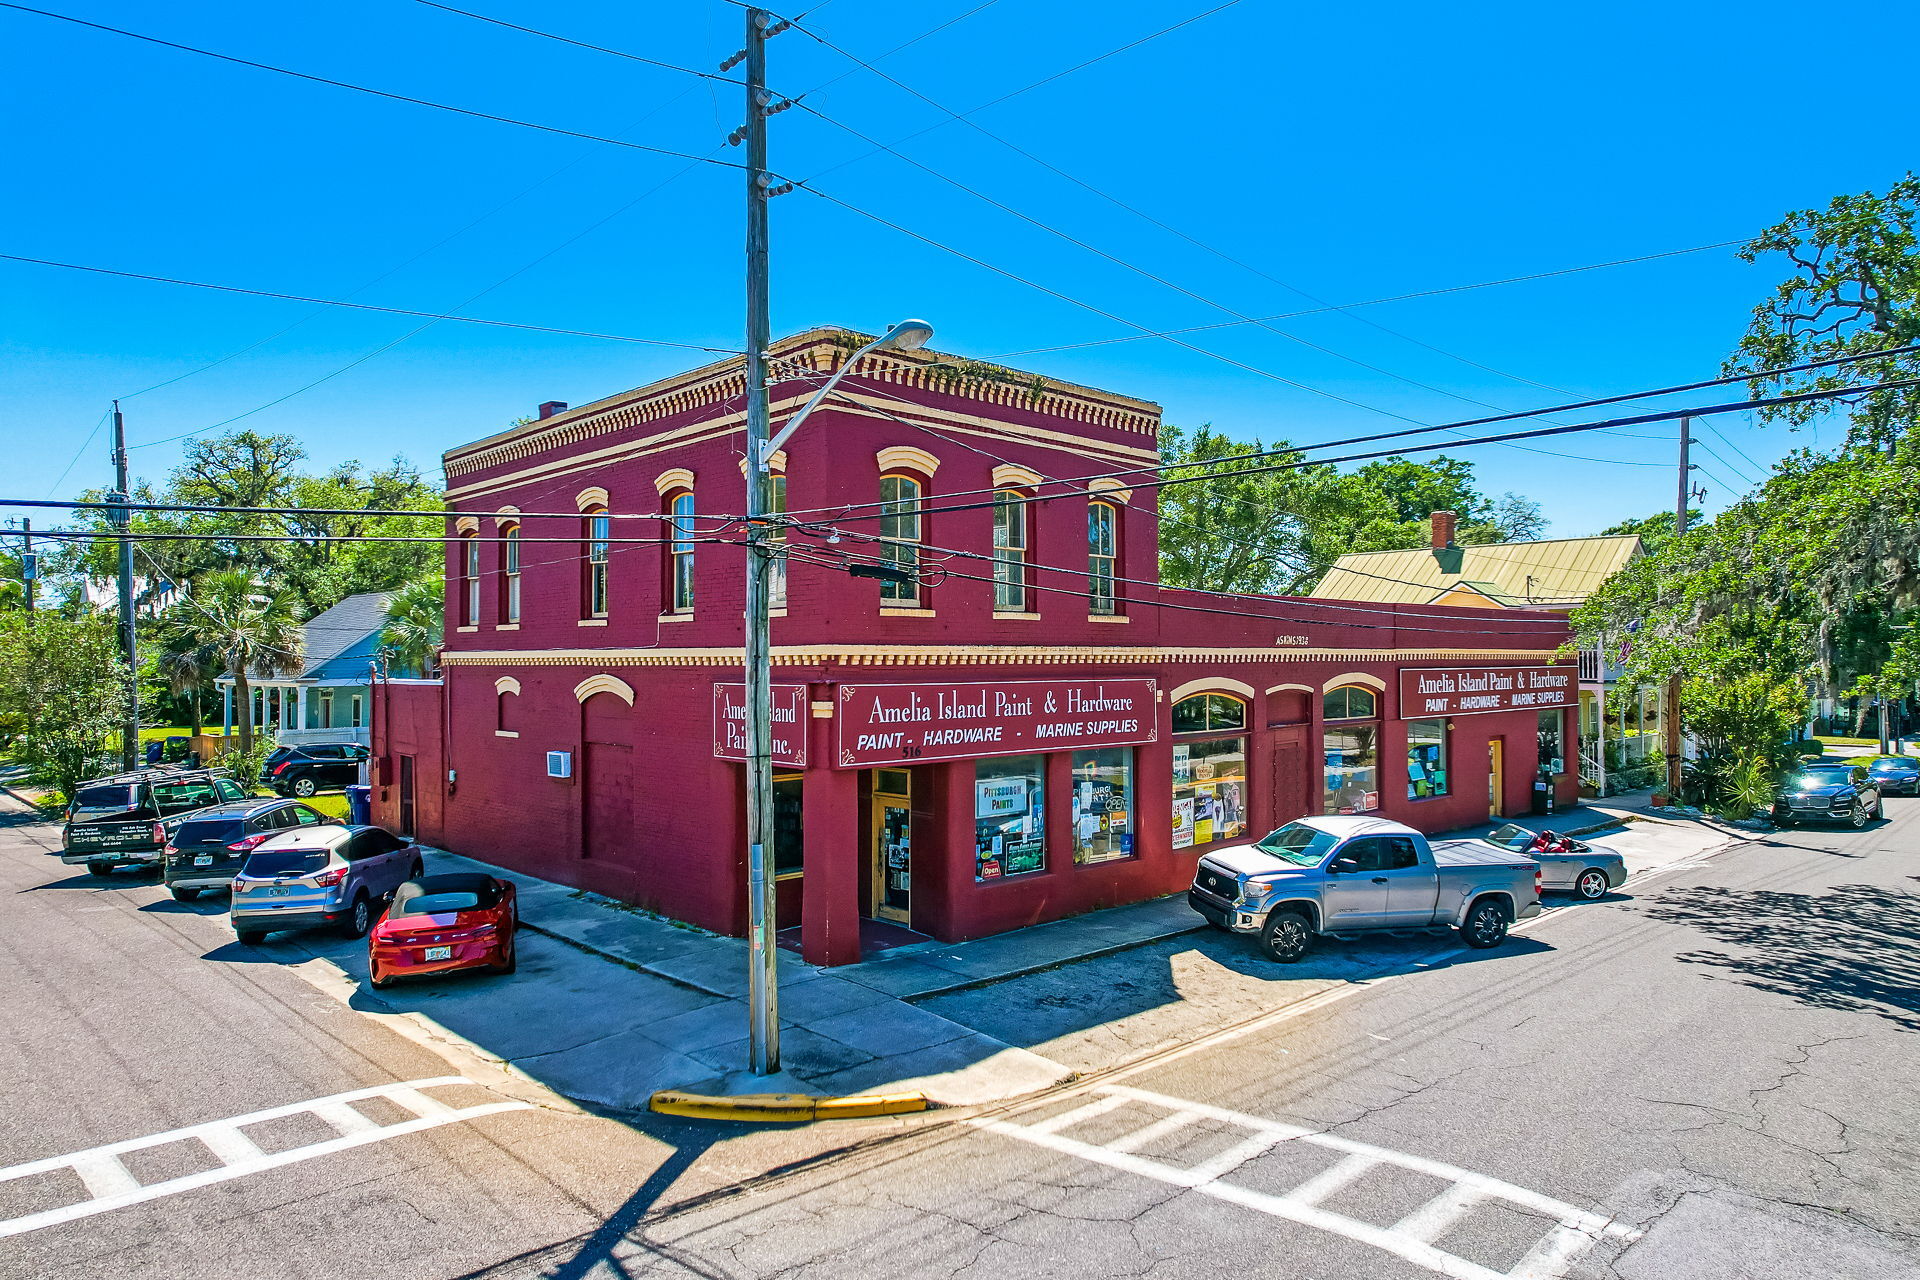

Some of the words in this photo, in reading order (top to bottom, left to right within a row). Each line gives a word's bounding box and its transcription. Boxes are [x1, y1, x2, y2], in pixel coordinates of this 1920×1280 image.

[1417, 674, 1455, 694] Amelia
[1457, 672, 1488, 693] Island
[1489, 672, 1513, 691] Paint
[1517, 671, 1525, 689] &
[1529, 670, 1569, 689] Hardware
[868, 691, 932, 724] Amelia
[937, 689, 987, 720] Island
[994, 691, 1033, 717] Paint
[1044, 690, 1058, 714] &
[1067, 685, 1133, 714] Hardware
[1425, 698, 1449, 712] PAINT
[1460, 695, 1500, 710] HARDWARE
[1511, 693, 1536, 706] MARINE
[1537, 691, 1565, 703] SUPPLIES
[857, 732, 905, 751] PAINT
[923, 726, 1003, 747] HARDWARE
[1035, 722, 1084, 739] MARINE
[1086, 719, 1138, 736] SUPPLIES
[902, 745, 922, 759] 516
[73, 833, 149, 843] CHEVROLET
[984, 866, 999, 875] Open
